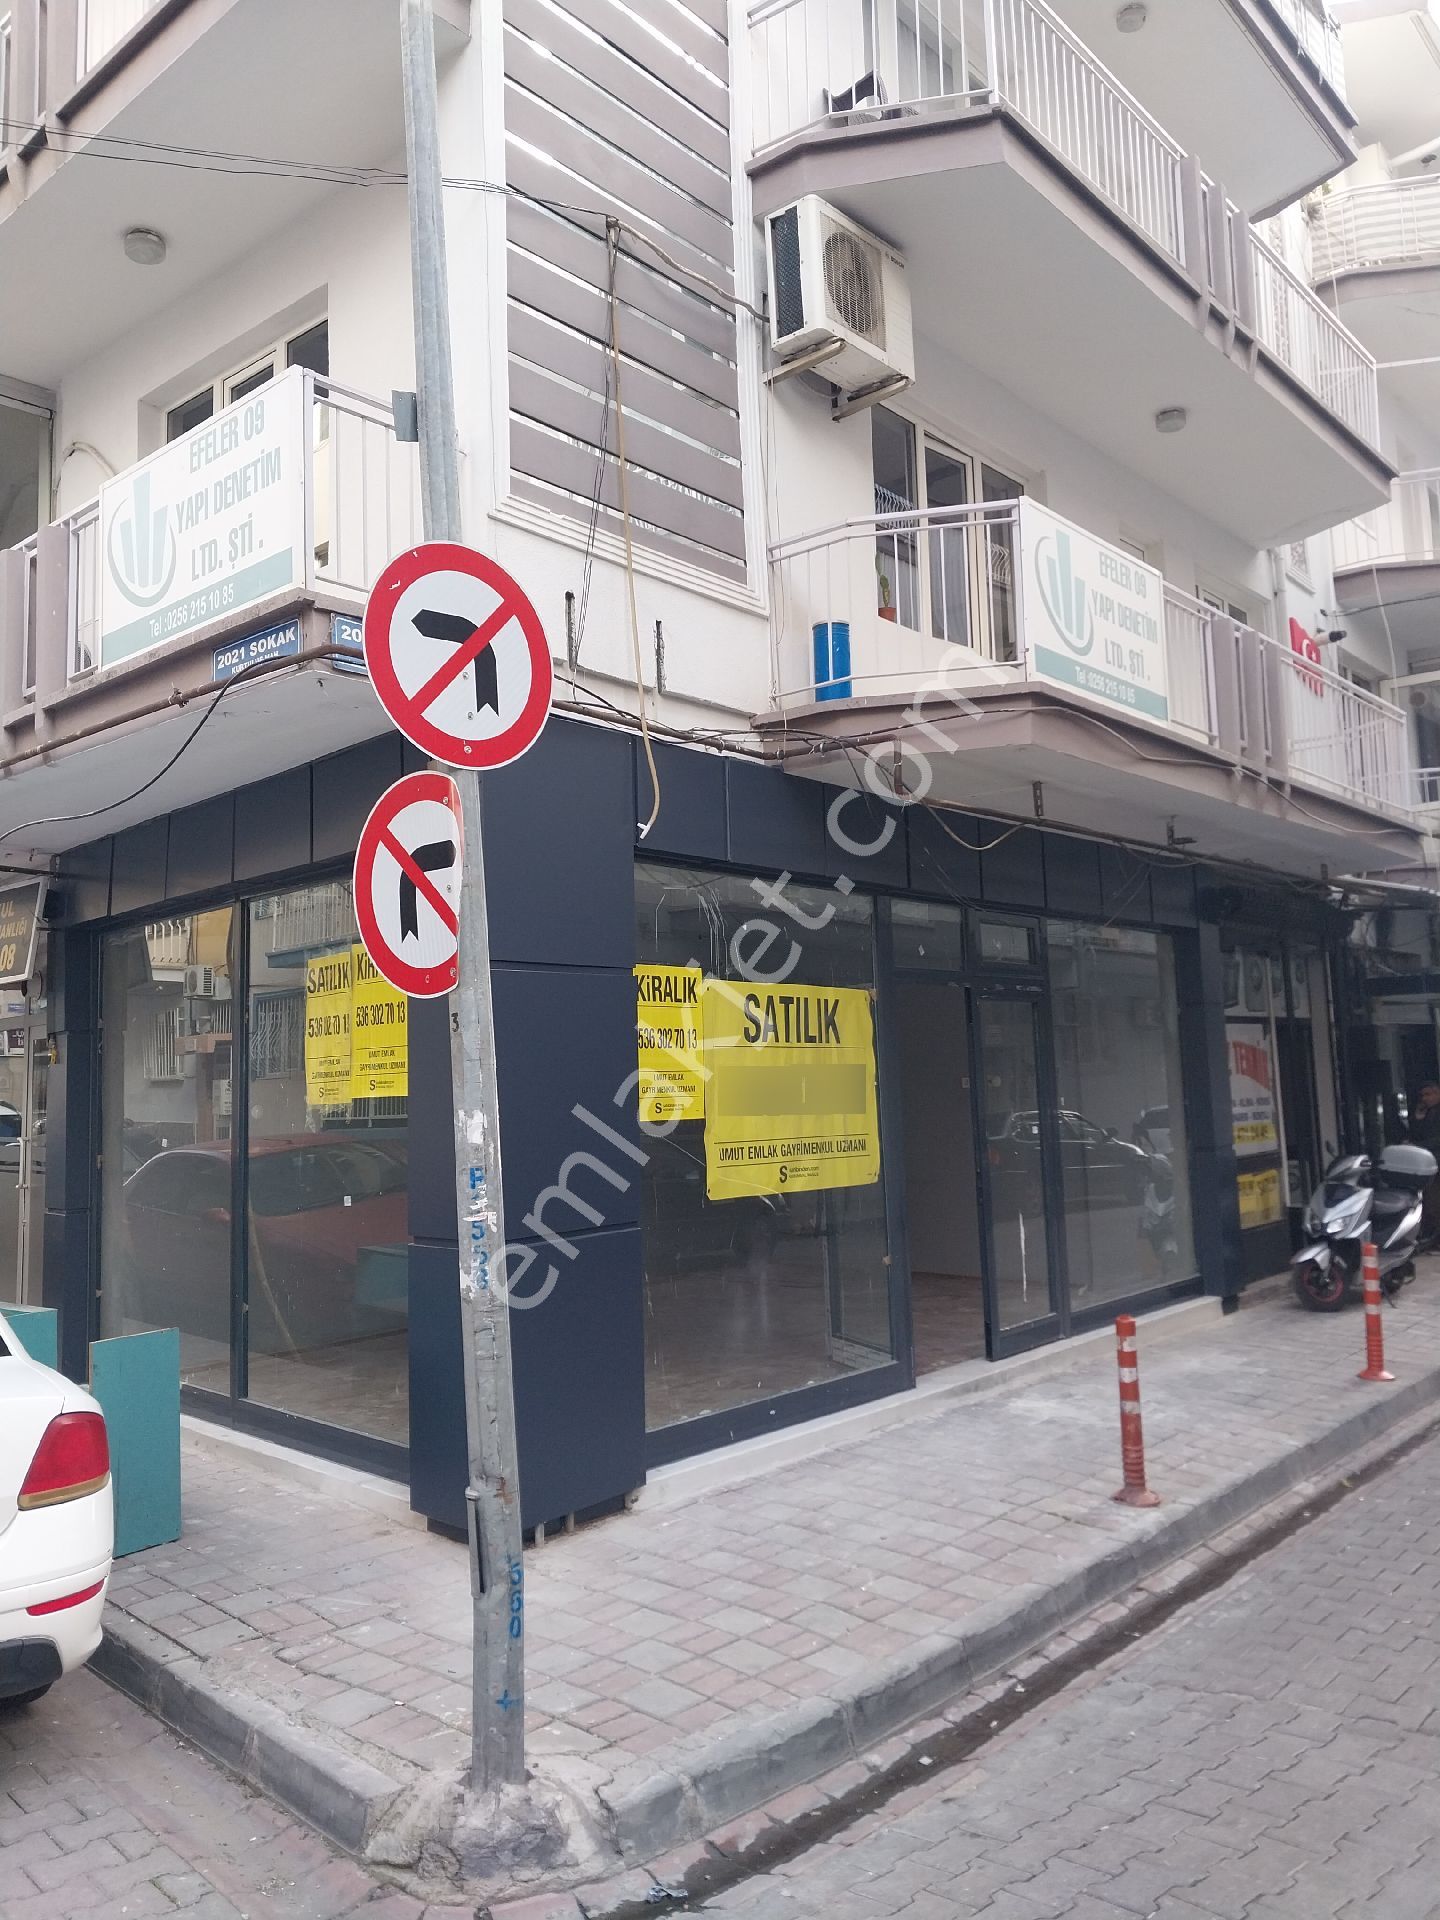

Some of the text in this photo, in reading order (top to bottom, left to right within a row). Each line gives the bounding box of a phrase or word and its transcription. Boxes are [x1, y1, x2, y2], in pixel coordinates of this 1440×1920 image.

[190, 399, 265, 474] EFELER 09
[175, 447, 281, 534] YAPI DENETİM
[191, 539, 223, 582] LTD.
[1099, 550, 1146, 599] EFELER 09
[189, 599, 208, 622] 215
[208, 591, 220, 613] 10
[222, 583, 234, 605] 85
[1091, 588, 1157, 644] YAPI DENETİM
[217, 626, 296, 669] 2021 SOKAK
[341, 625, 362, 643] 20
[1104, 637, 1127, 671] LTD.
[1105, 679, 1117, 697] 215
[0, 900, 15, 918] UL
[307, 961, 351, 994] SATILIK
[308, 1014, 323, 1038] 536
[356, 1000, 406, 1028] 536 302 70 13
[743, 993, 841, 1045] SATILIK
[638, 1027, 698, 1050] 536 302 70 13
[719, 1138, 867, 1161] UMUT EMLAK GAYRİMENKUL UZMANI
